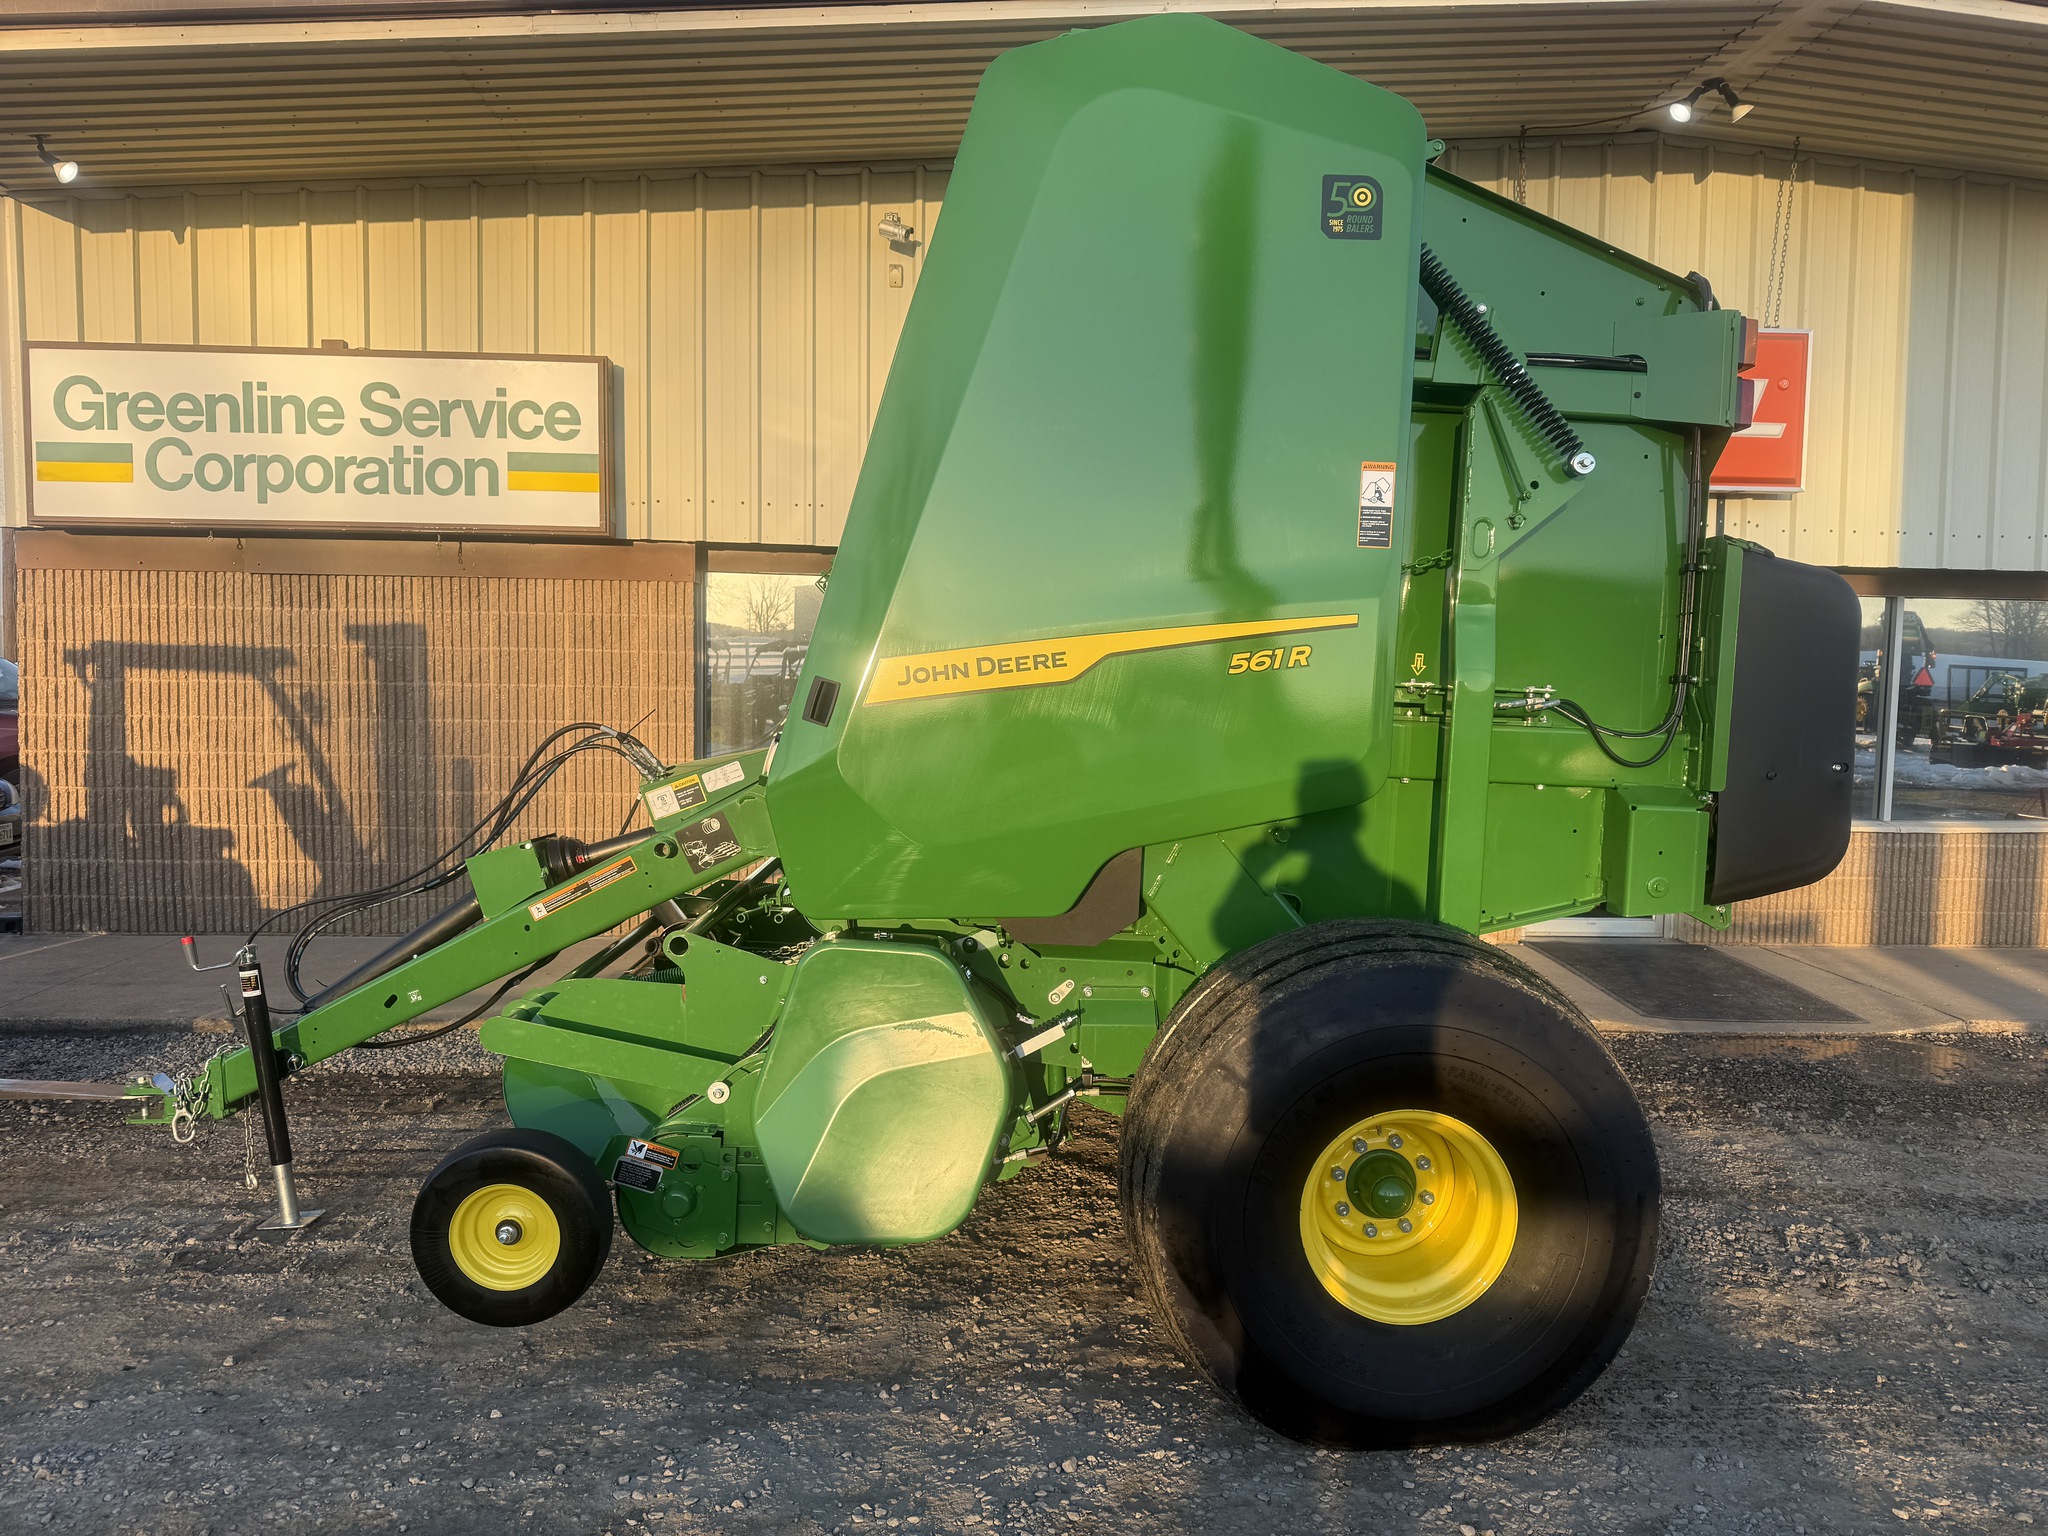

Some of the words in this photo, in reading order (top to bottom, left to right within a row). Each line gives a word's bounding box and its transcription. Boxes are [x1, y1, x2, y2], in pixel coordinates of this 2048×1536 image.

[1346, 215, 1373, 224] ROUND
[1346, 224, 1374, 233] BALERS
[53, 374, 345, 436] Greenline
[359, 380, 581, 441] Service
[144, 436, 500, 504] Corporation
[897, 662, 970, 686] JOHN
[976, 651, 1068, 678] DEERE
[1227, 647, 1286, 675] 561
[1286, 644, 1313, 668] R
